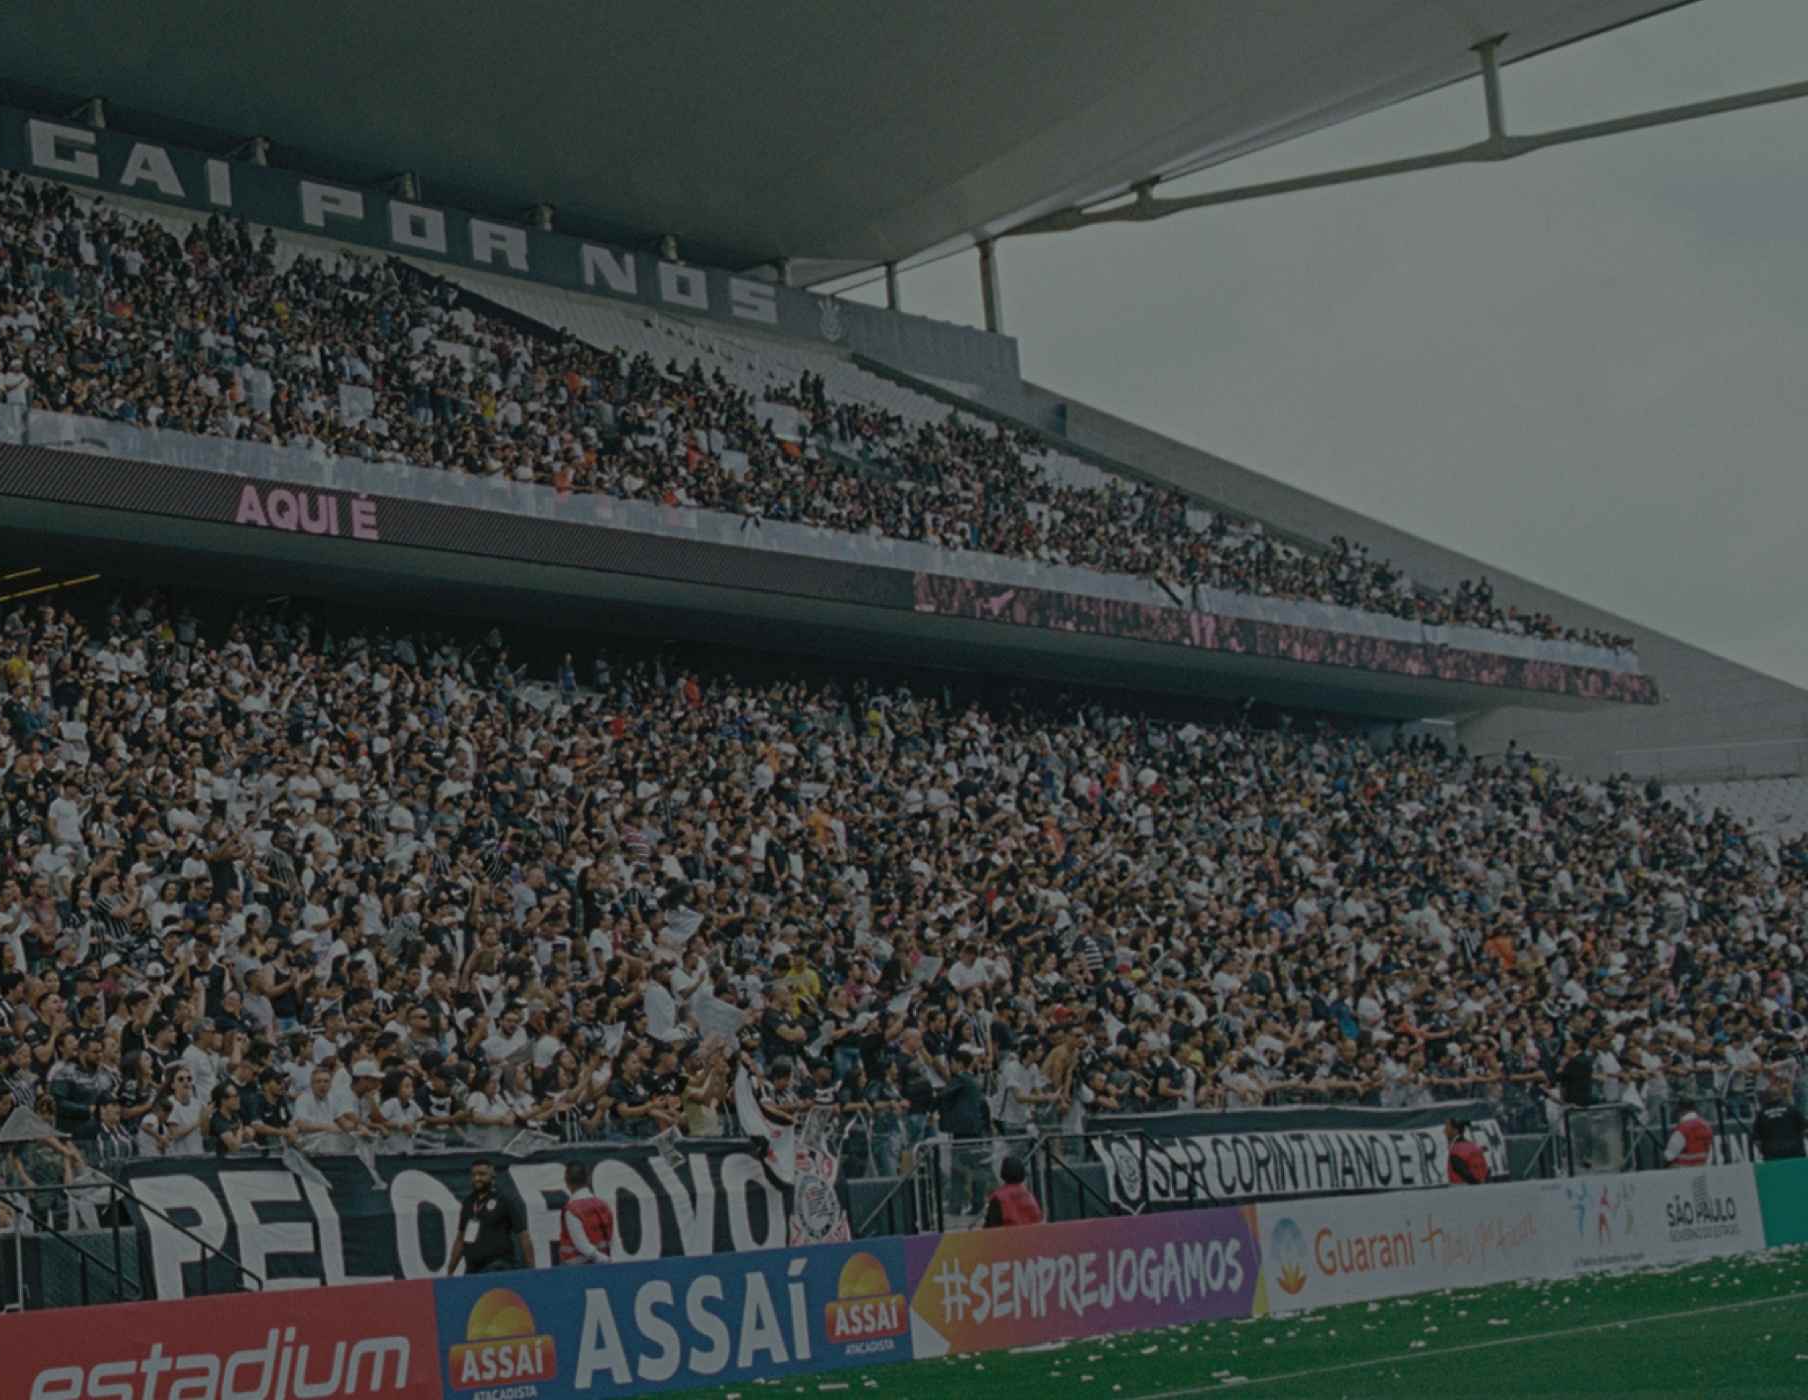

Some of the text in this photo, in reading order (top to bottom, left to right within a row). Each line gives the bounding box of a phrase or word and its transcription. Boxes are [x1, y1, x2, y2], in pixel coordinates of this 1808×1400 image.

[300, 177, 529, 273] POR
[236, 484, 389, 541] AQUI É
[1144, 1137, 1214, 1199] SER
[1211, 1132, 1392, 1196] CORINTHIANO
[1415, 1131, 1443, 1184] IR
[1666, 1194, 1737, 1227] SÃO PAULO
[1314, 1217, 1416, 1276] Guarani
[935, 1238, 1244, 1325] #SEMPREJOGAMOS
[575, 1256, 812, 1389] ASSAÍ
[30, 1325, 411, 1400] estadium
[461, 1337, 544, 1383] ASSAÍ
